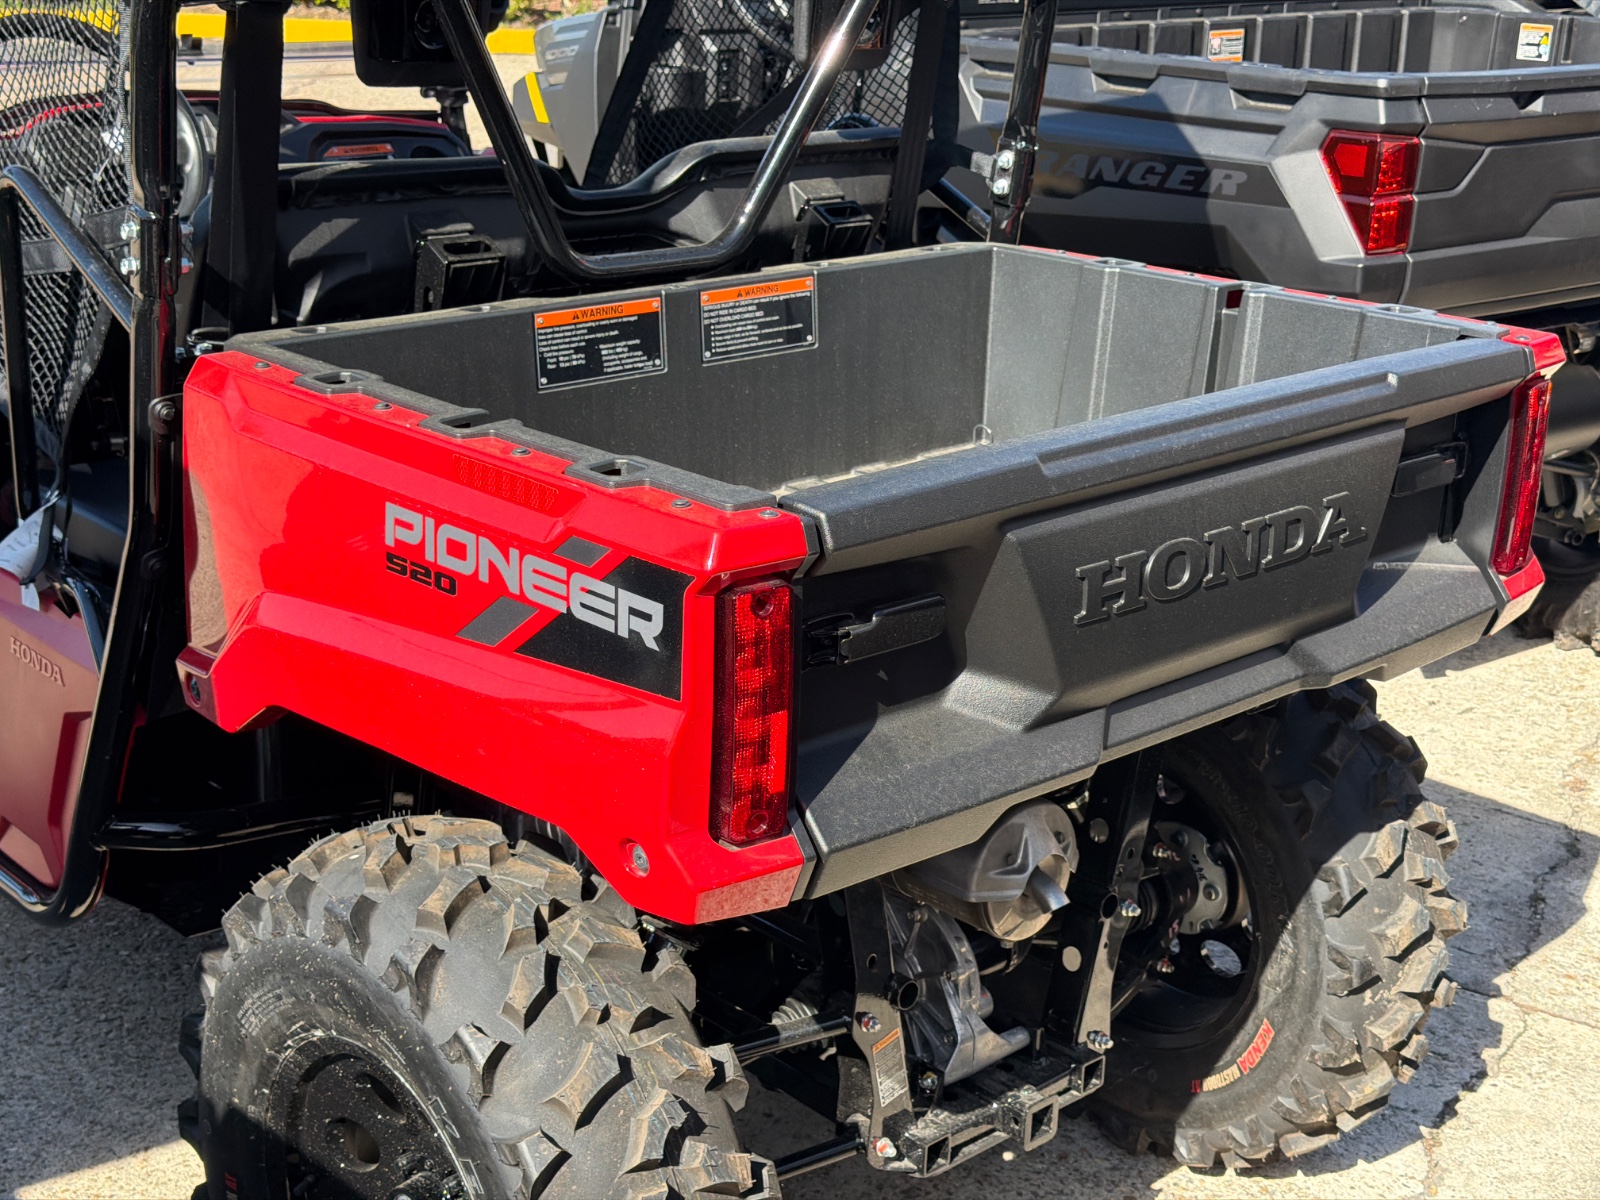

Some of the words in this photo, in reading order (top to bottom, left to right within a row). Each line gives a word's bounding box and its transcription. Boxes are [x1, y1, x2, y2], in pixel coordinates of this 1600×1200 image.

[581, 305, 624, 319] WARNING
[744, 285, 779, 297] WARNING
[385, 501, 664, 652] PIONEER
[386, 552, 457, 596] 520
[1074, 491, 1367, 625] HONDA
[9, 634, 66, 687] HONDA
[1236, 1017, 1275, 1075] KENDA
